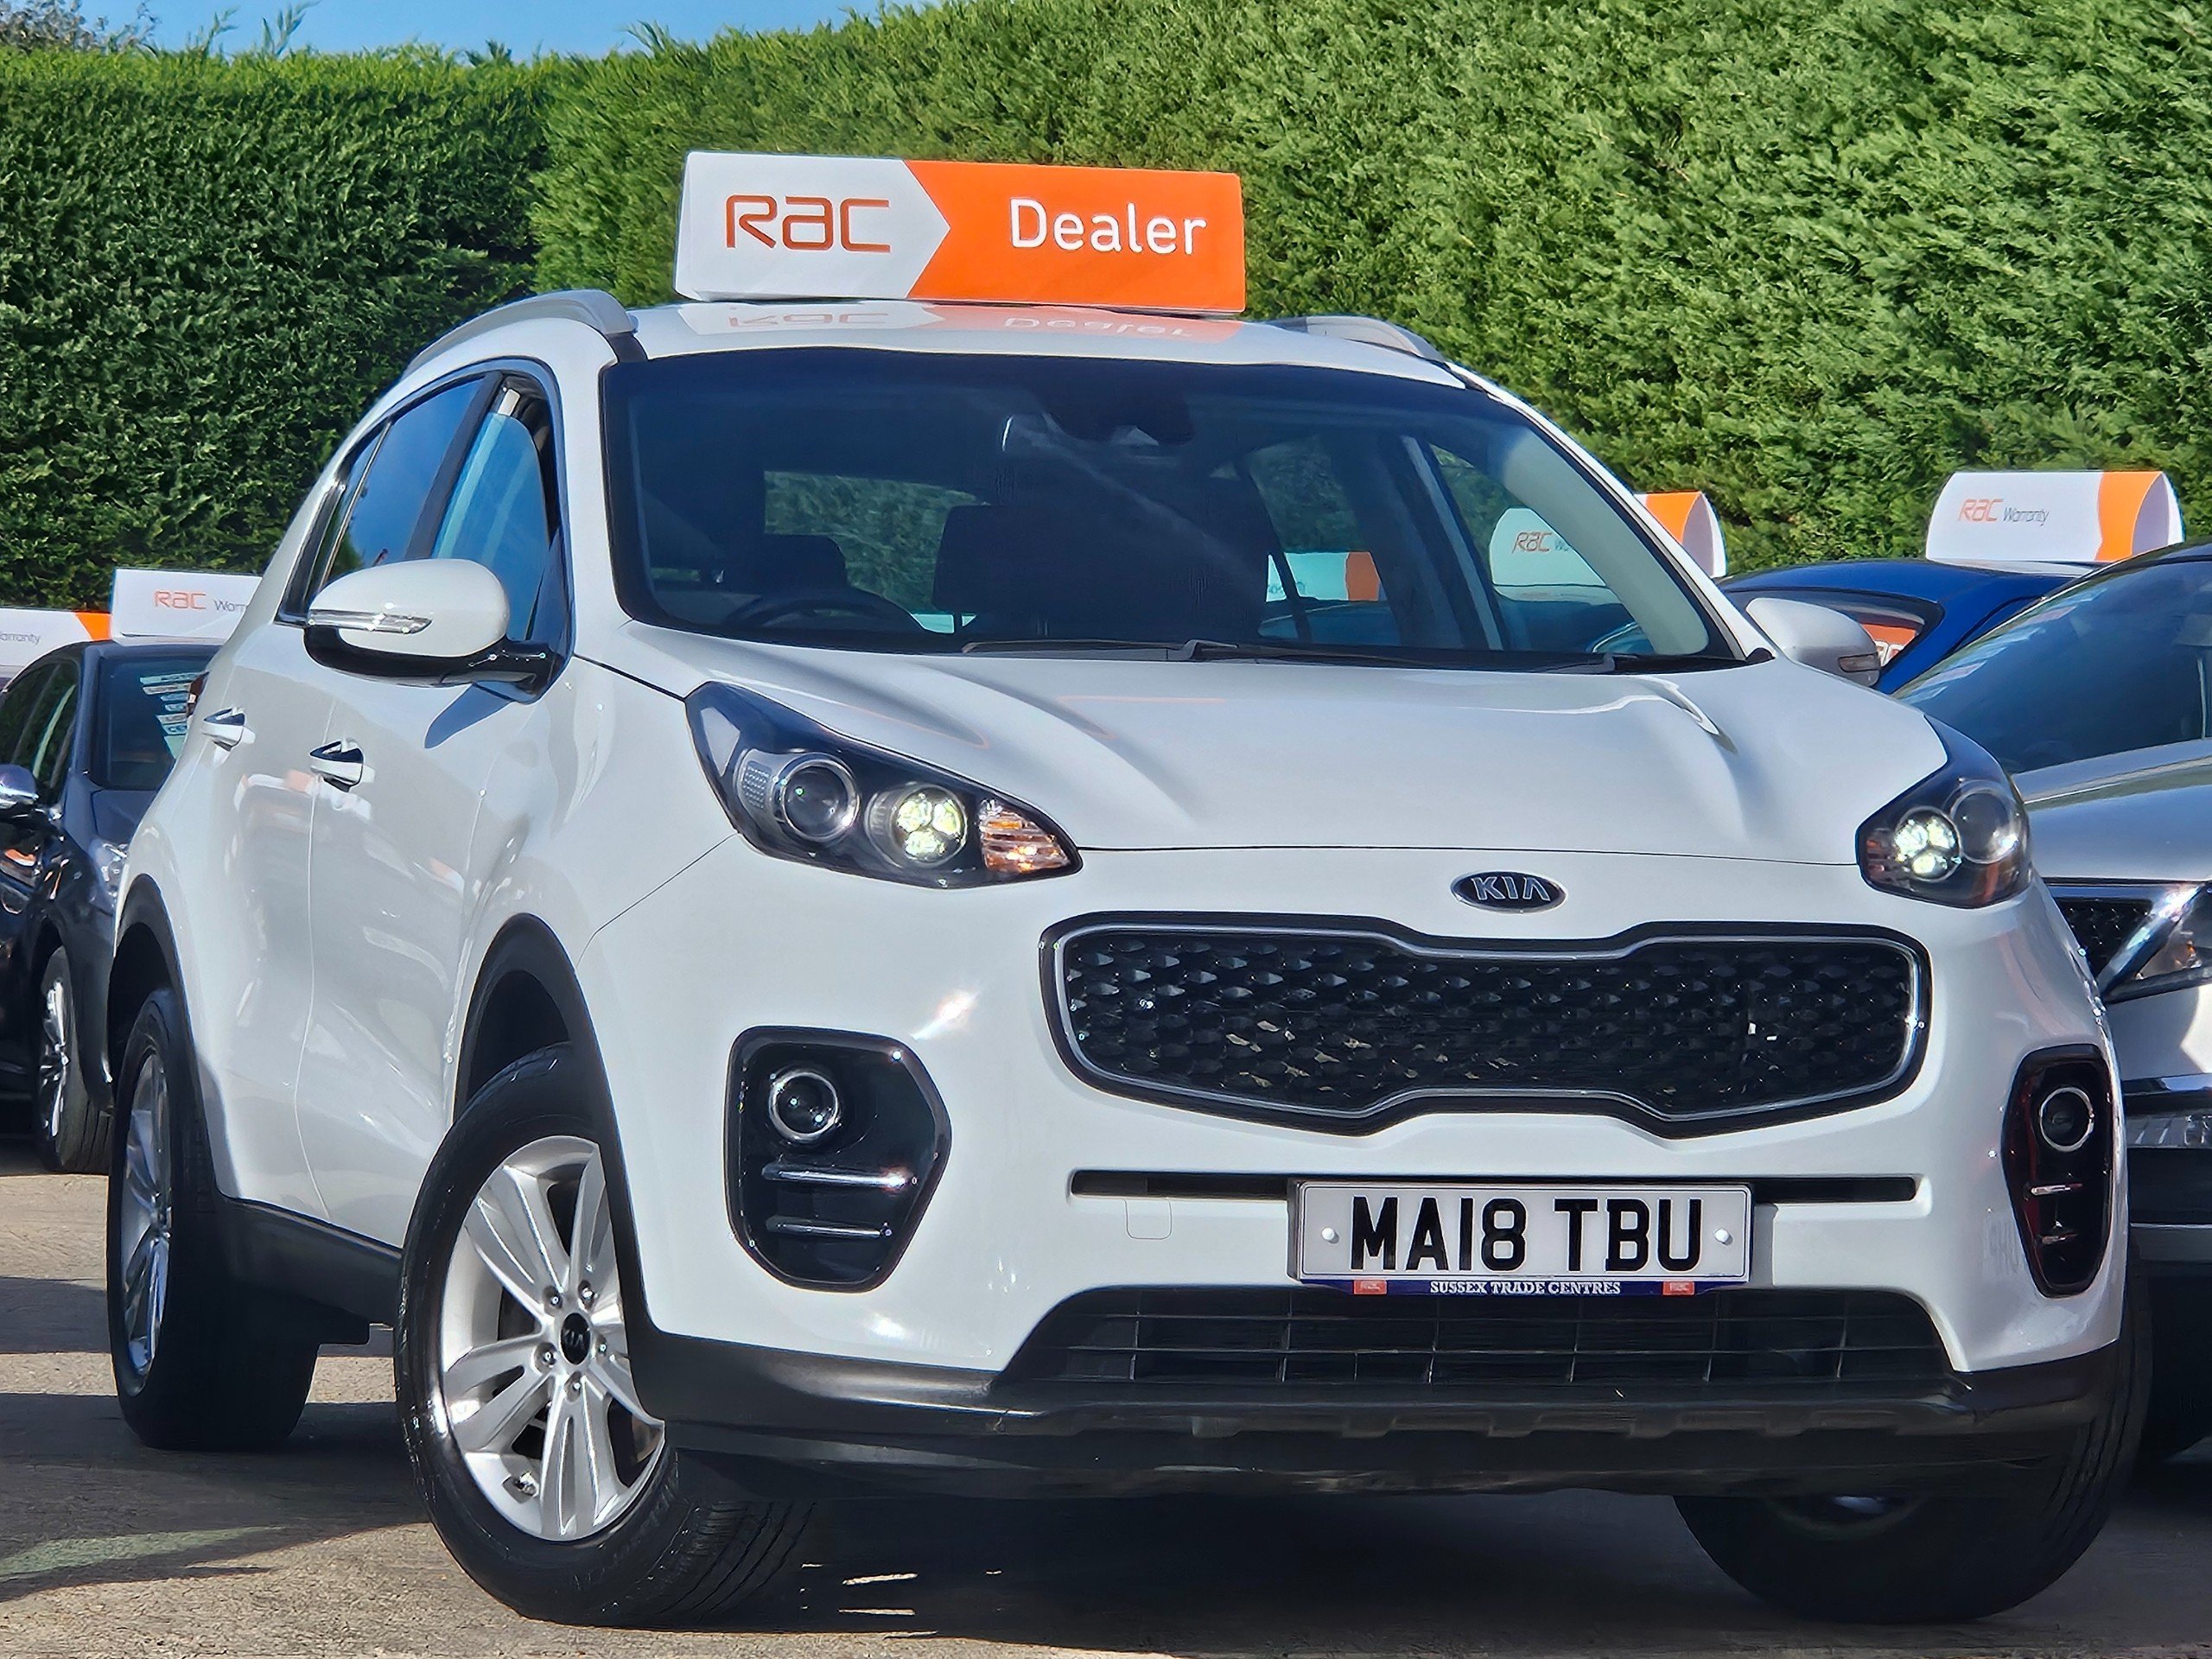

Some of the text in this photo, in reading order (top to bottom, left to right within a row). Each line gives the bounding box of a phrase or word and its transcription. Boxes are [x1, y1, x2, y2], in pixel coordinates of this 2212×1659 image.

[1009, 197, 1207, 256] Dealer
[1471, 876, 1552, 902] KIA
[1350, 1195, 1703, 1273] MA18 TBU
[1430, 1281, 1621, 1295] SUSSEX TRADE CENTRES
